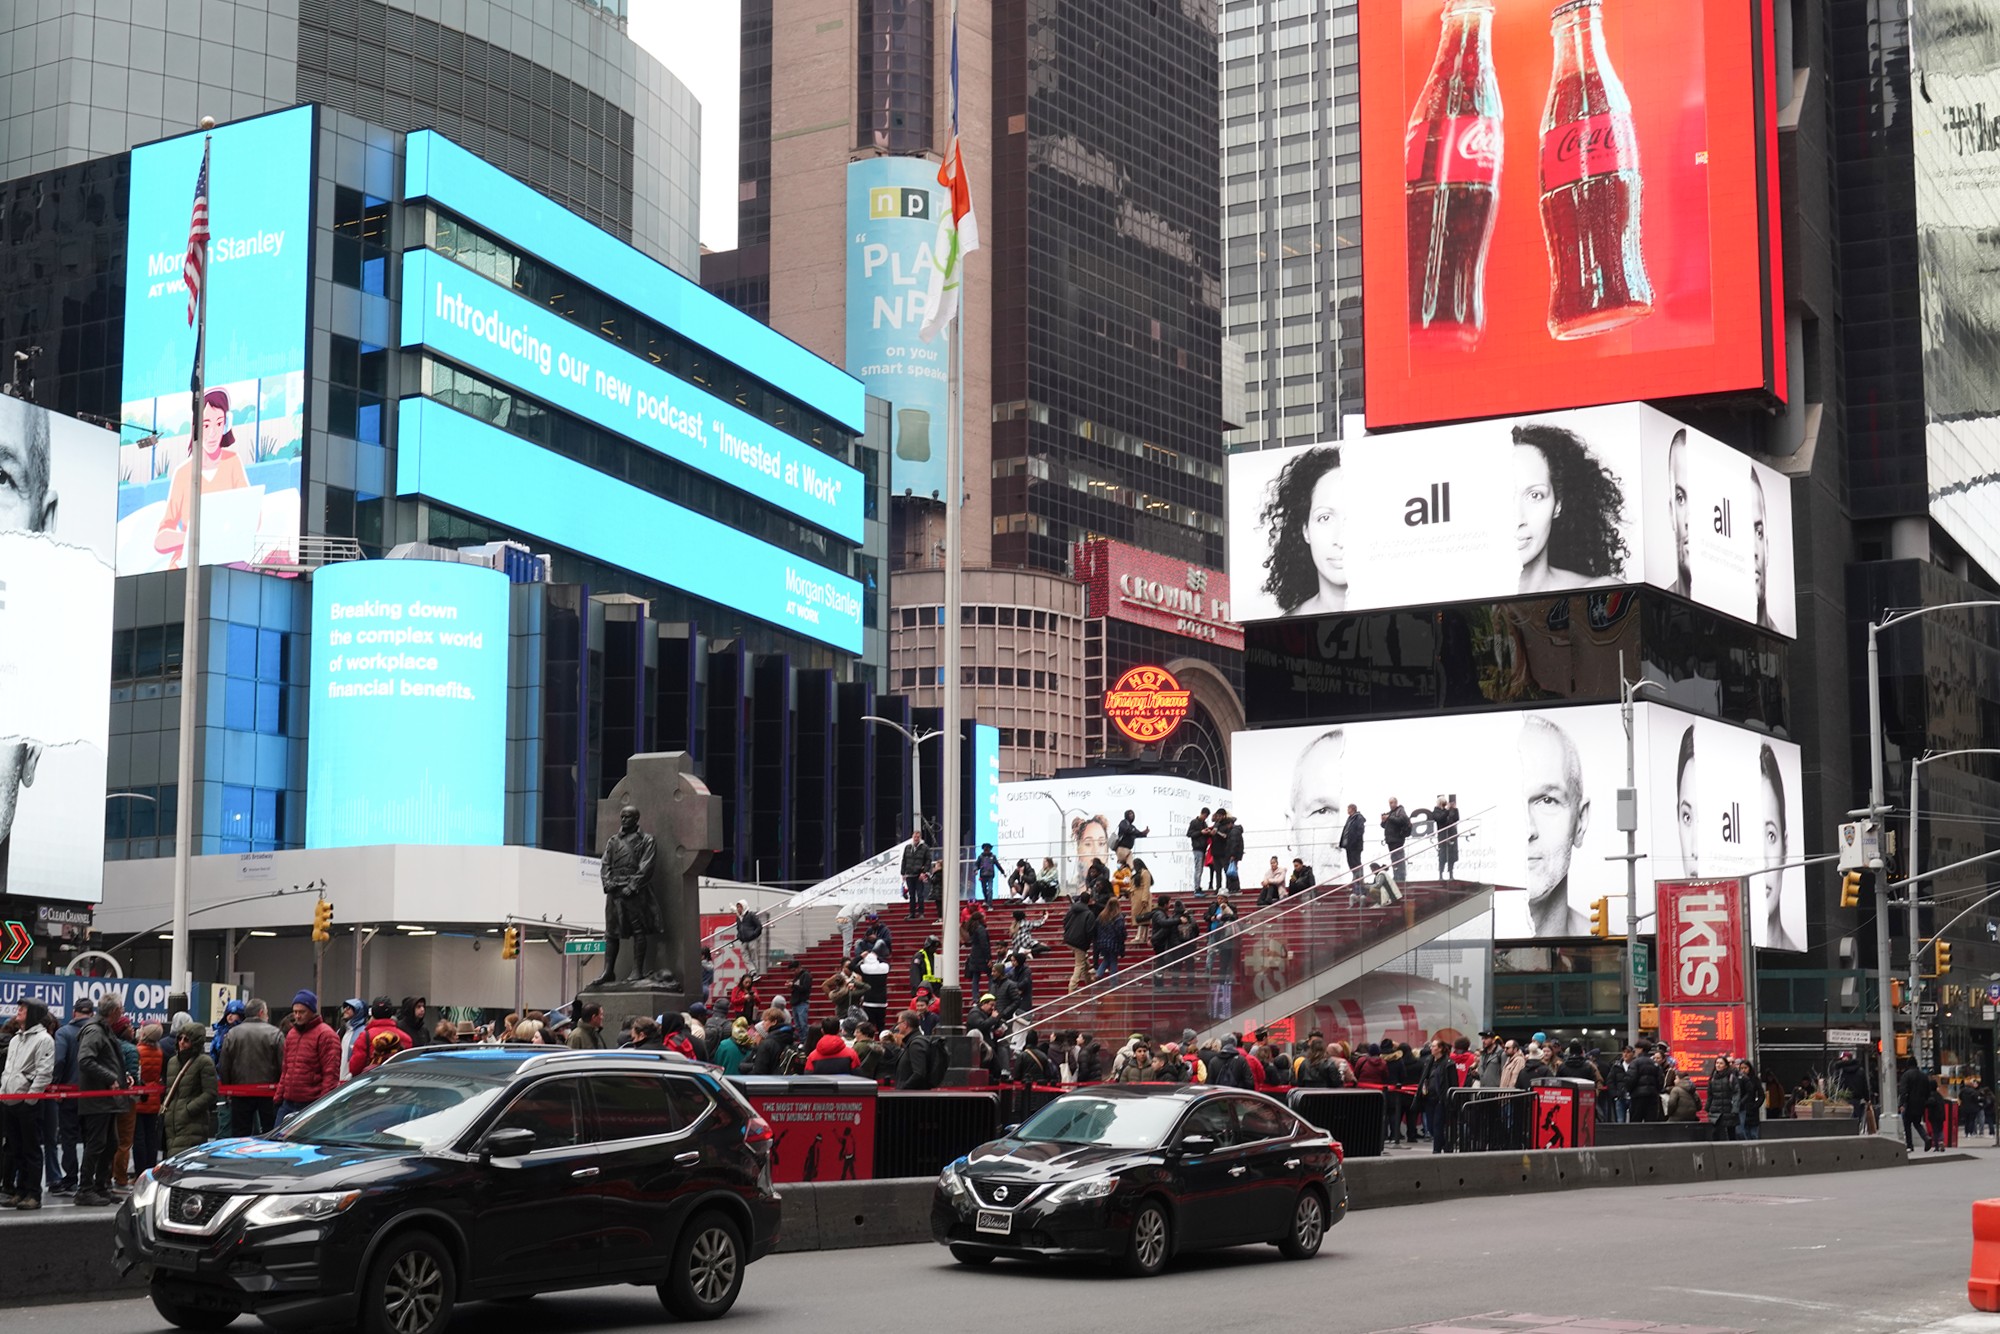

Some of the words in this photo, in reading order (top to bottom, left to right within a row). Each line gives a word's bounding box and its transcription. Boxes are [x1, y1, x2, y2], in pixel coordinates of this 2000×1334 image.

[148, 246, 213, 277] Morn
[216, 230, 285, 262] Stanley
[148, 284, 163, 299] AT
[166, 279, 188, 295] WO
[886, 345, 905, 357] on
[909, 346, 938, 361] your
[861, 361, 904, 377] smart
[906, 364, 947, 383] speake
[435, 282, 551, 364] Introducing
[558, 353, 590, 383] our
[595, 366, 632, 407] new
[636, 389, 708, 448] podcast,
[712, 420, 781, 480] “Invested
[785, 462, 799, 489] at
[1404, 482, 1451, 527] all
[1713, 497, 1732, 539] all
[786, 566, 824, 606] Morgan
[825, 582, 862, 624] Stanley
[331, 600, 402, 620] Breaking
[408, 601, 457, 619] down
[786, 602, 796, 616] AT
[797, 606, 820, 625] WORK
[330, 629, 351, 646] the
[356, 626, 434, 646] complex
[439, 632, 483, 649] world
[329, 655, 342, 672] of
[346, 653, 439, 672] workplace
[328, 679, 394, 699] financial
[400, 679, 476, 700] benefits.
[1128, 671, 1166, 690] HOT
[1108, 709, 1151, 717] ORIGINAL
[1128, 719, 1169, 736] NOW
[1068, 789, 1091, 800] Hinge
[1722, 803, 1741, 844] all
[575, 943, 582, 952] W
[583, 943, 592, 952] 47
[593, 942, 601, 951] St
[1678, 889, 1729, 997] tkts
[34, 982, 63, 1004] FIN
[73, 980, 129, 1009] NOW
[763, 1103, 774, 1112] THE
[776, 1103, 794, 1111] MOST
[795, 1102, 811, 1111] TONY
[812, 1102, 862, 1111] AWARD-WINNING
[771, 1113, 785, 1122] NEW
[786, 1113, 814, 1122] MUSICAL
[815, 1113, 823, 1121] OF
[824, 1113, 836, 1121] THE
